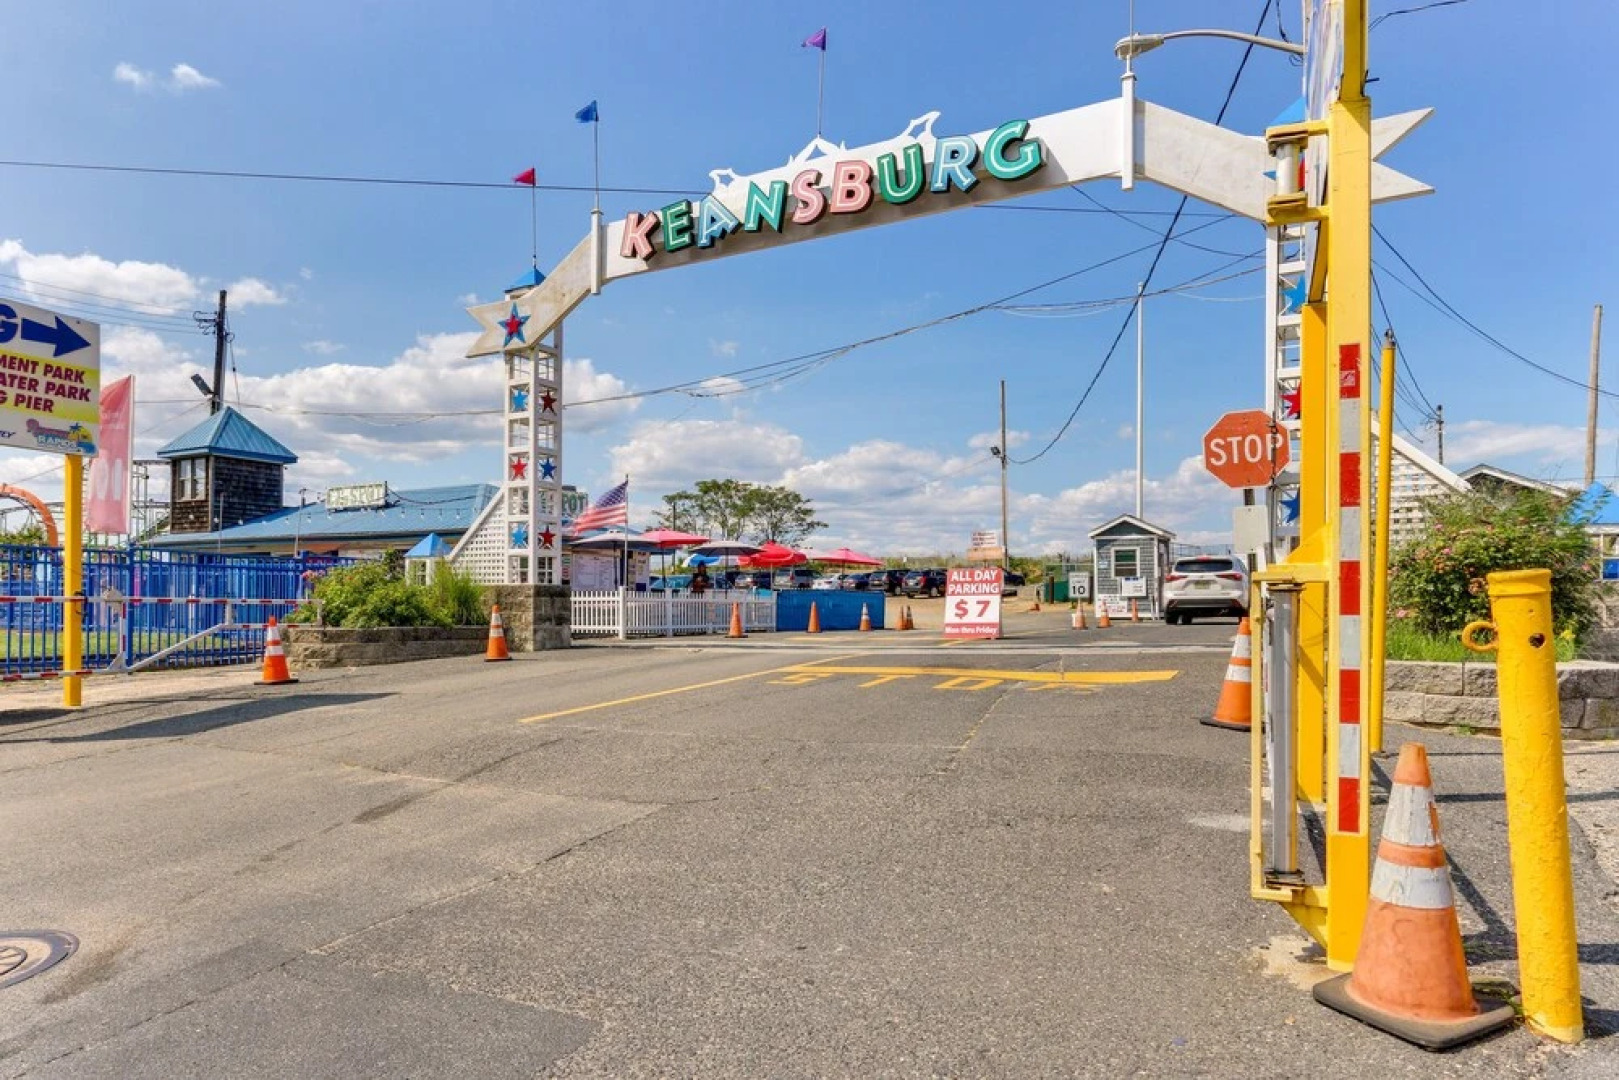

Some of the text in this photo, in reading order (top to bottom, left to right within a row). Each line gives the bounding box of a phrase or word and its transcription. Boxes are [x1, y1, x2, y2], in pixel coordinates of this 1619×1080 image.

[619, 119, 1046, 260] KEANSBURG
[43, 363, 85, 384] PARK
[45, 381, 91, 402] PARK
[14, 393, 54, 413] PIER
[1210, 433, 1284, 466] STOP
[951, 569, 998, 581] ALL DAY
[948, 582, 999, 595] PARKING
[1072, 585, 1086, 595] 10
